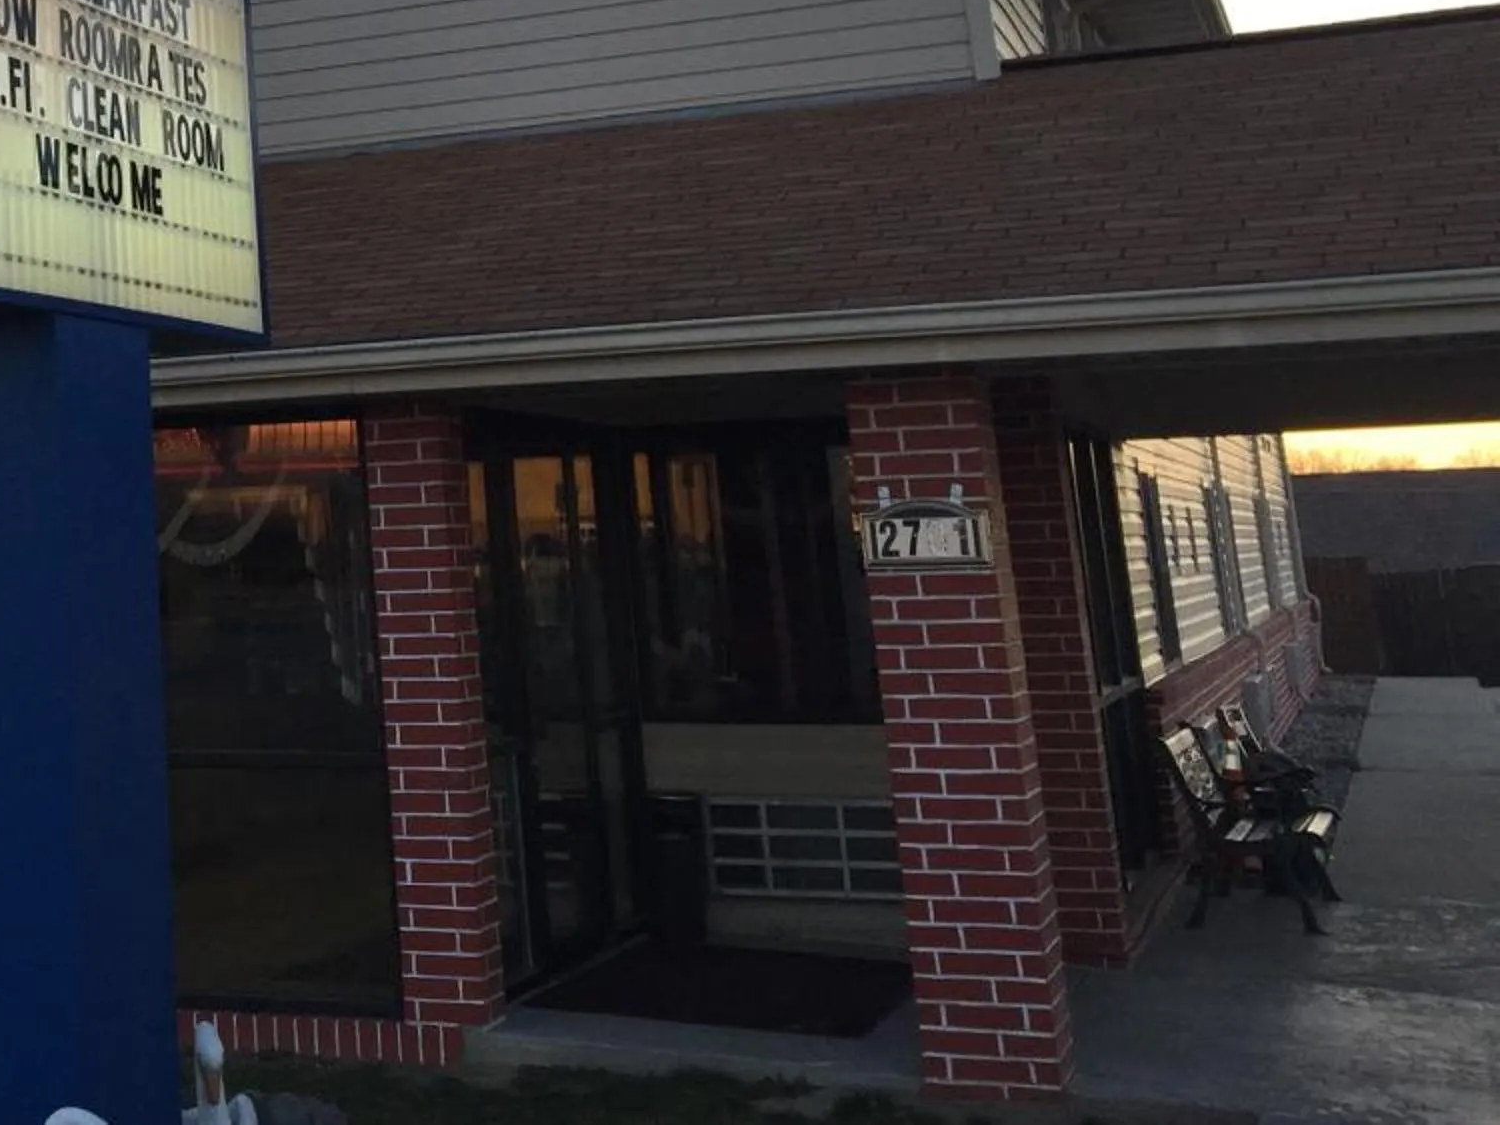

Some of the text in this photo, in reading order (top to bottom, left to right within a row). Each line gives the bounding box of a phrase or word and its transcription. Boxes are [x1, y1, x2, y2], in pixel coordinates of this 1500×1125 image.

[67, 77, 141, 146] CLEAN
[162, 109, 225, 172] ROOM
[36, 133, 164, 216] WELCOME
[879, 519, 970, 557] 271
